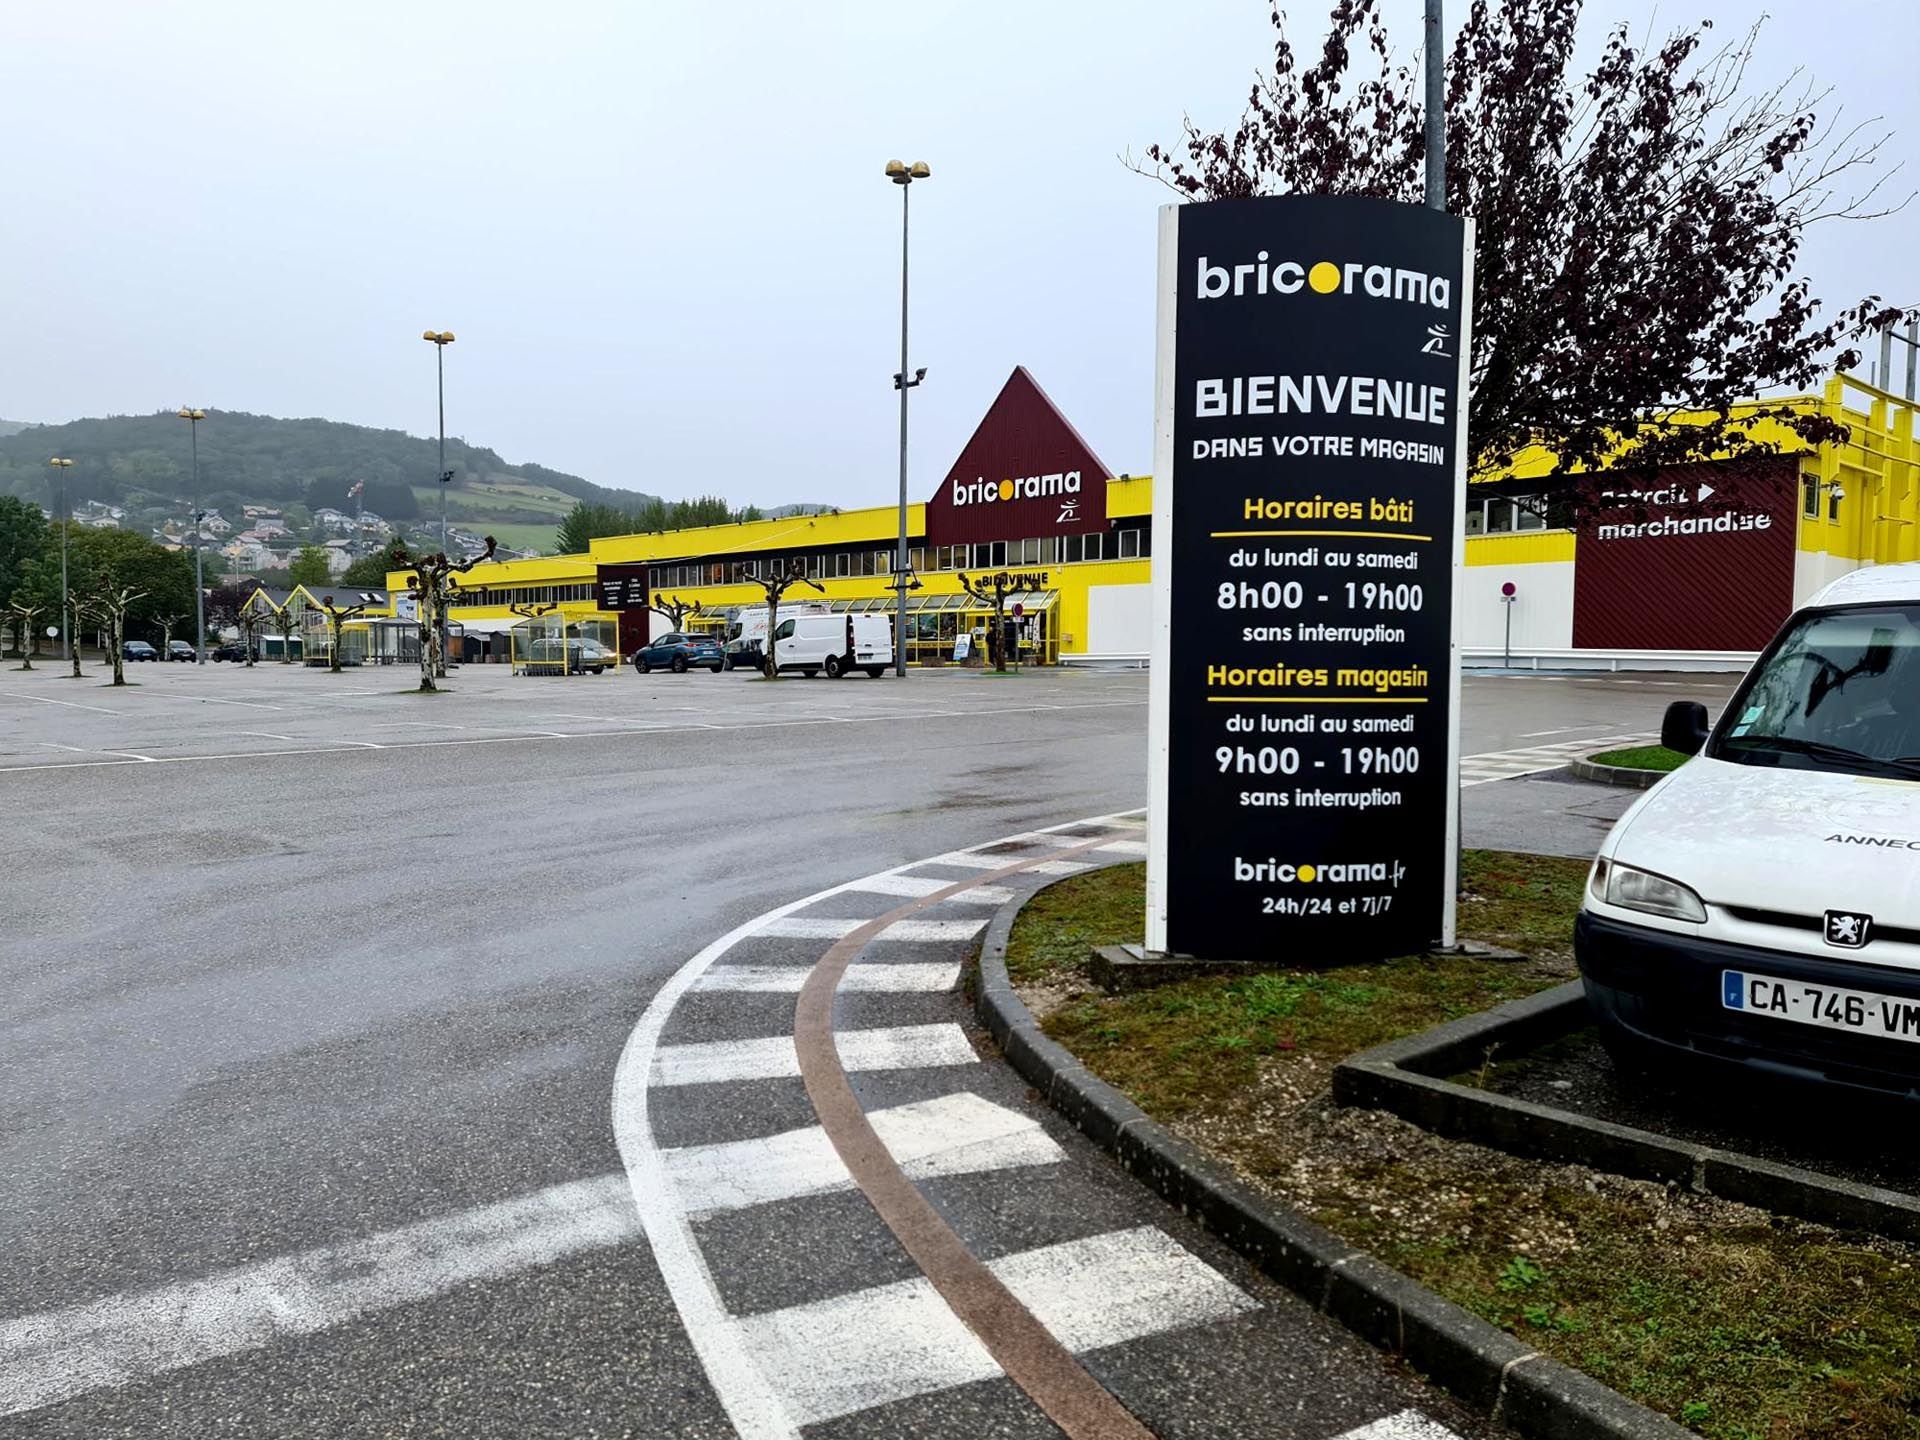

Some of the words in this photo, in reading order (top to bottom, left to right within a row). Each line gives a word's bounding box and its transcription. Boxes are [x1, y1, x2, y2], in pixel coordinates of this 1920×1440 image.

[1197, 251, 1450, 309] bricorama
[1196, 375, 1446, 424] BIENVENUE
[1193, 437, 1263, 459] DANS
[1272, 436, 1353, 456] VOTRE
[1361, 438, 1444, 465] MAGASIN
[953, 470, 1080, 506] bricorama
[1600, 483, 1689, 508] trait
[1245, 495, 1362, 519] Horaires
[1370, 498, 1413, 522] bâti
[1598, 511, 1772, 540] marchandise
[1229, 549, 1257, 567] du
[1265, 548, 1318, 566] lundi
[1325, 552, 1351, 566] au
[1357, 552, 1417, 569] samedi
[1218, 581, 1303, 609] 8h00
[1345, 582, 1422, 611] 19h00
[1243, 627, 1292, 641] sans
[1299, 623, 1404, 645] interruption
[1208, 663, 1328, 686] Horaires
[1337, 664, 1427, 692] magasin
[1226, 714, 1254, 732] du
[1261, 714, 1314, 732] lundi
[1321, 719, 1347, 732] au
[1353, 715, 1414, 732] samedi
[1216, 747, 1299, 774] 9h00
[1342, 747, 1419, 774] 19h00
[1240, 792, 1289, 806] sans
[1296, 788, 1401, 810] interruption
[1235, 857, 1405, 887] bricorama.fr
[1263, 898, 1332, 916] 24h/24
[1339, 898, 1356, 913] et
[1362, 896, 1392, 915] 7j/7
[1750, 980, 1920, 1037] CA-746-VM
